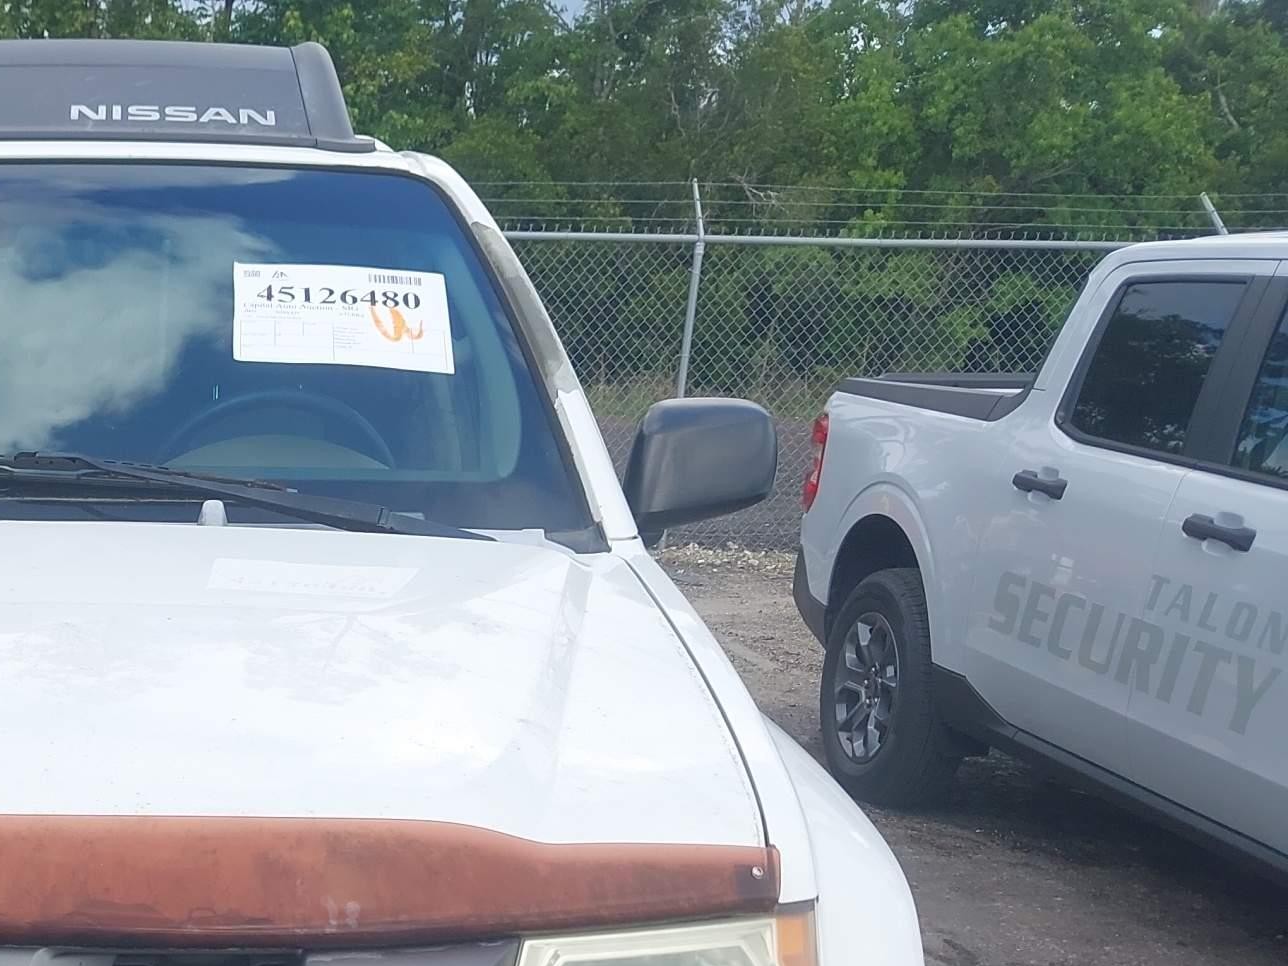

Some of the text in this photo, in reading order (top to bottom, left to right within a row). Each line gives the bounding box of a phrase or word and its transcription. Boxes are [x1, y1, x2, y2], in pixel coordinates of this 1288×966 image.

[70, 104, 276, 126] NISSAN
[256, 283, 421, 310] 45126480
[1143, 574, 1288, 656] TALON
[987, 571, 1282, 736] SECURITY
